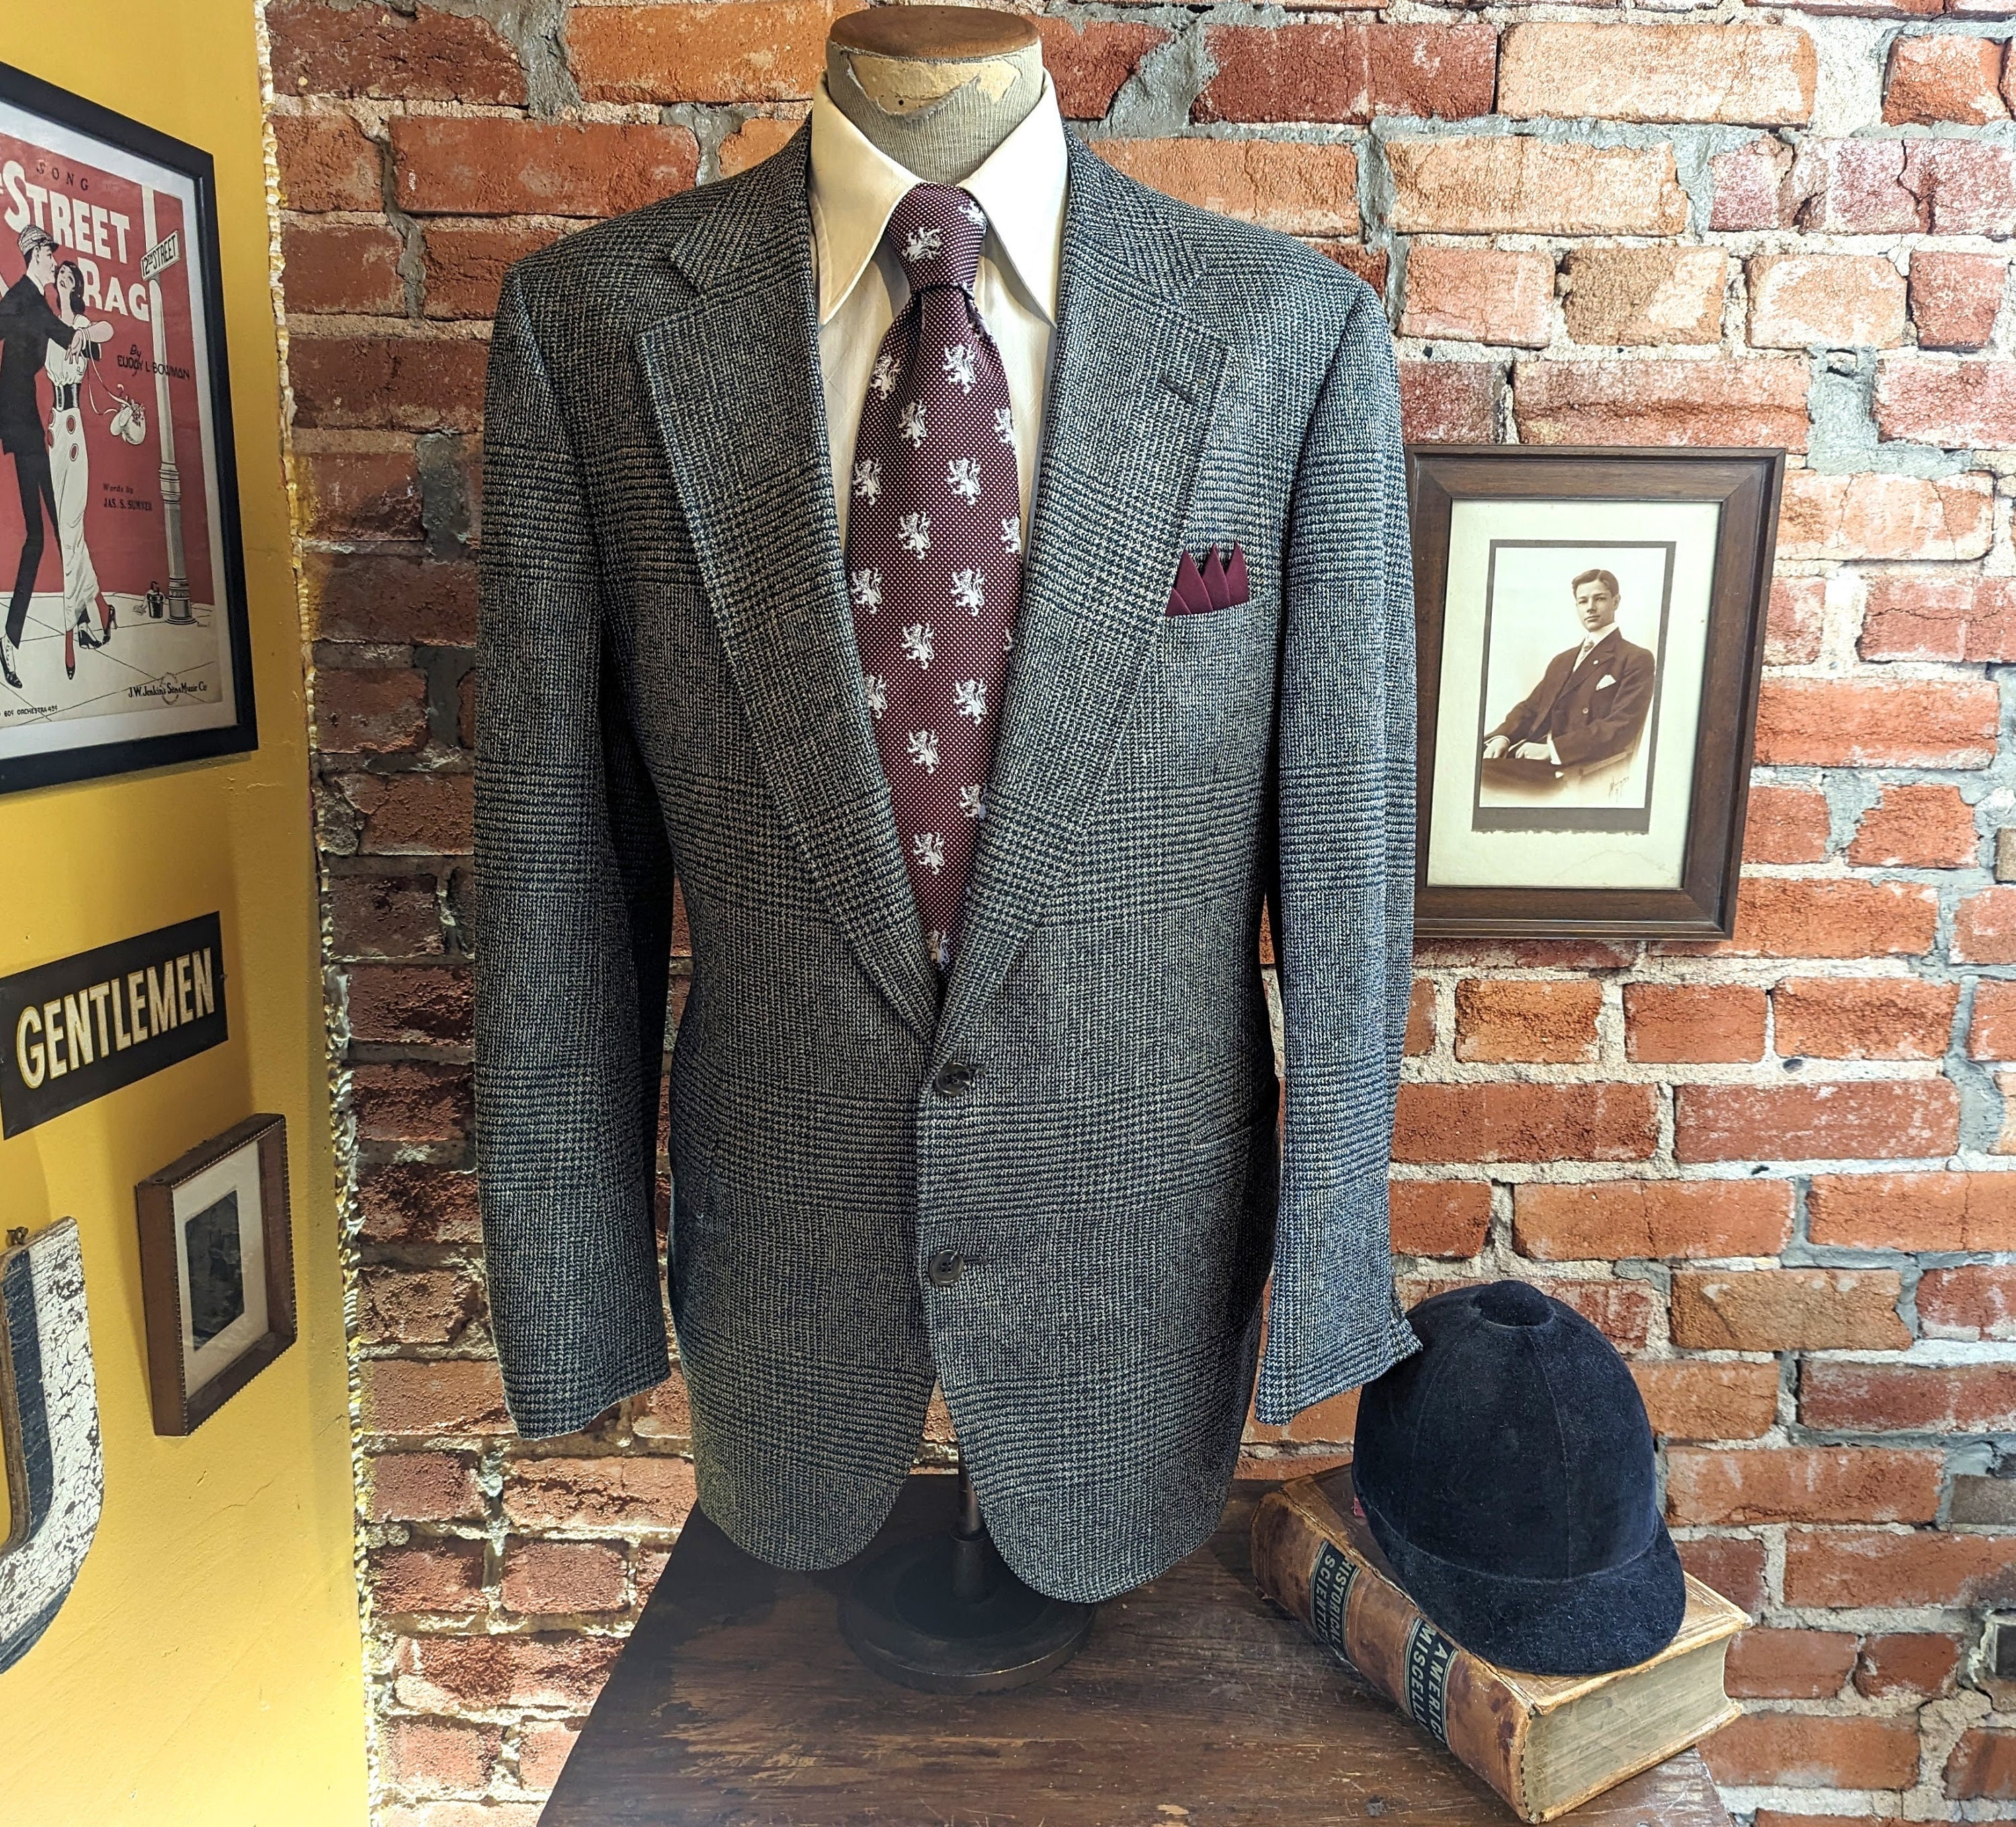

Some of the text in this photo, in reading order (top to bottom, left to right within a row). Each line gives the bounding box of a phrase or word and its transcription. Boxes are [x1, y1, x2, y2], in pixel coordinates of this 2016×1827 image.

[36, 162, 89, 191] SONG
[3, 160, 130, 265] STREET
[153, 235, 176, 269] STREET
[77, 257, 150, 322] RAG
[17, 706, 47, 715] ORCHESTRA
[16, 947, 215, 1089] GENTLEMEN
